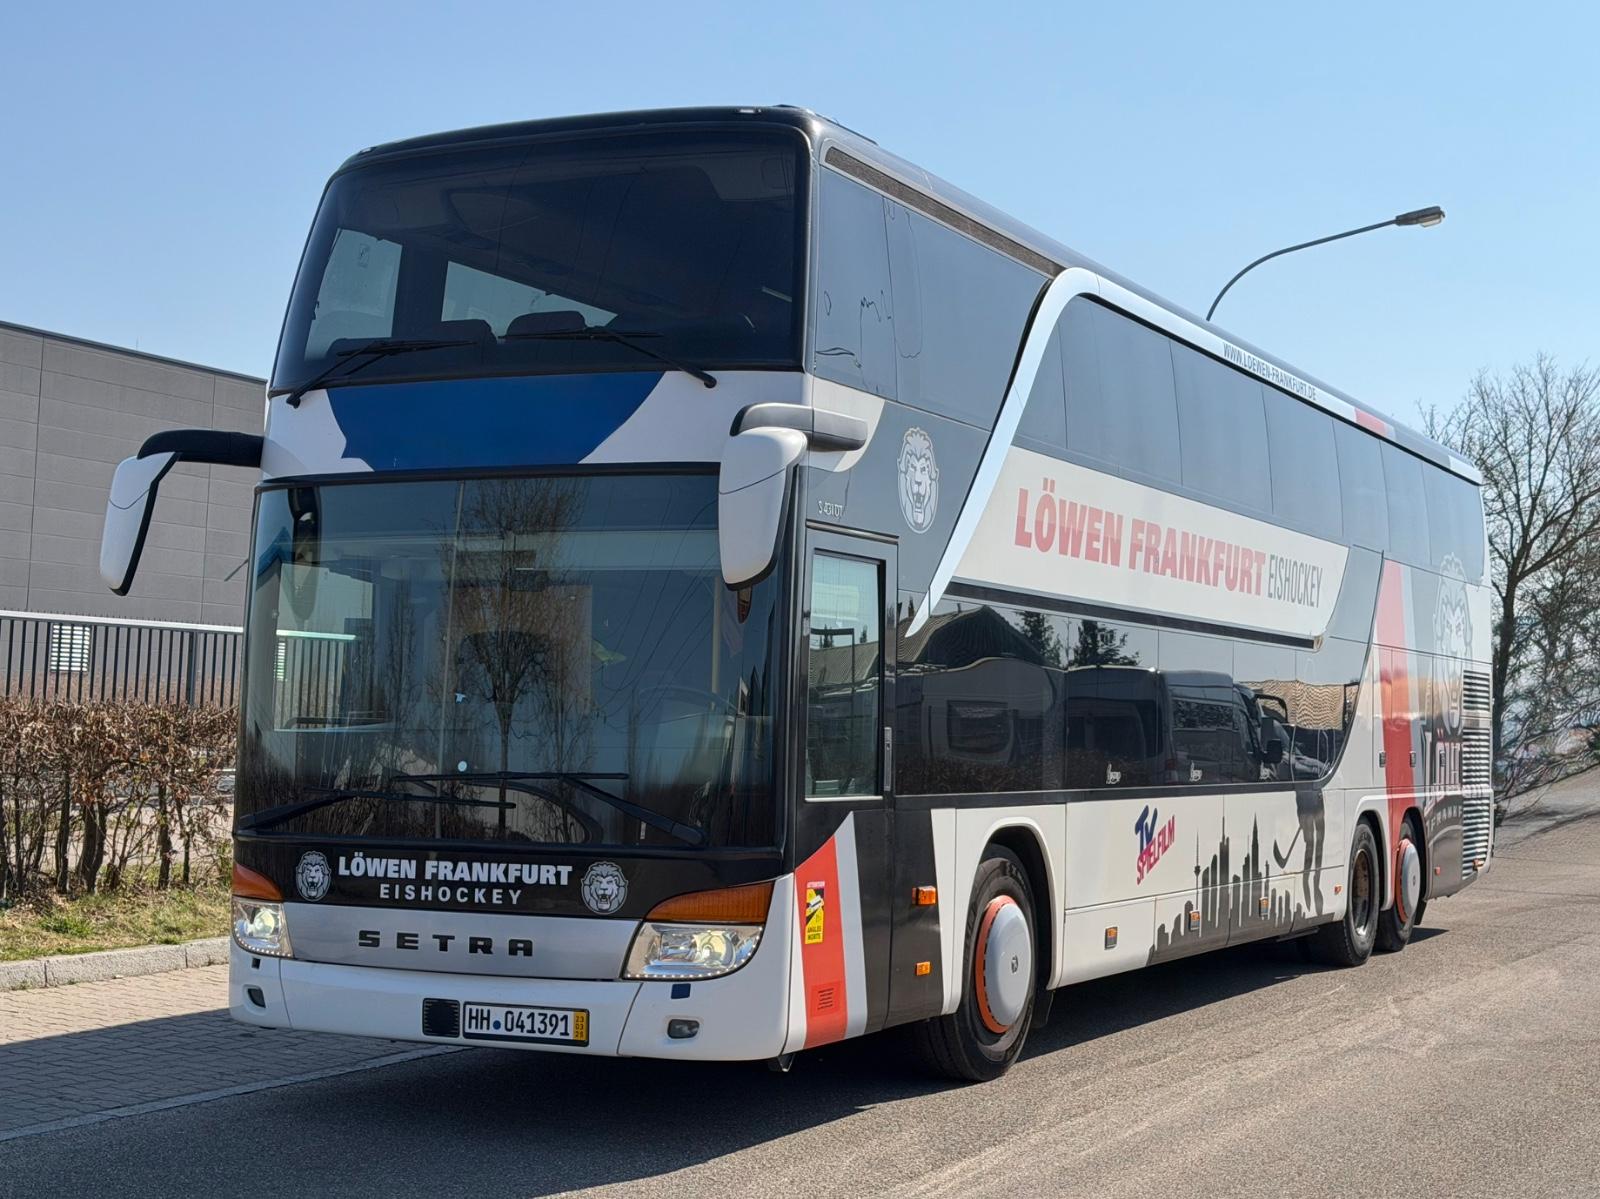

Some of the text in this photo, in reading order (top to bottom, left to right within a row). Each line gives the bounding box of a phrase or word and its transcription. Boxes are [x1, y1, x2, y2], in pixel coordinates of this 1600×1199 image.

[1223, 342, 1317, 401] WWW.LOEWEN-FRANKFURT.DE
[1015, 477, 1324, 609] LÖWEN FRANKFURT EISHOCKEY
[1135, 805, 1158, 854] TV
[1136, 814, 1175, 886] SPIELFILM
[338, 852, 573, 886] LÖWEN FRANKFURT
[379, 883, 522, 905] EISHOCKEY
[358, 930, 533, 957] SETRA
[468, 1008, 570, 1037] HH 041391
